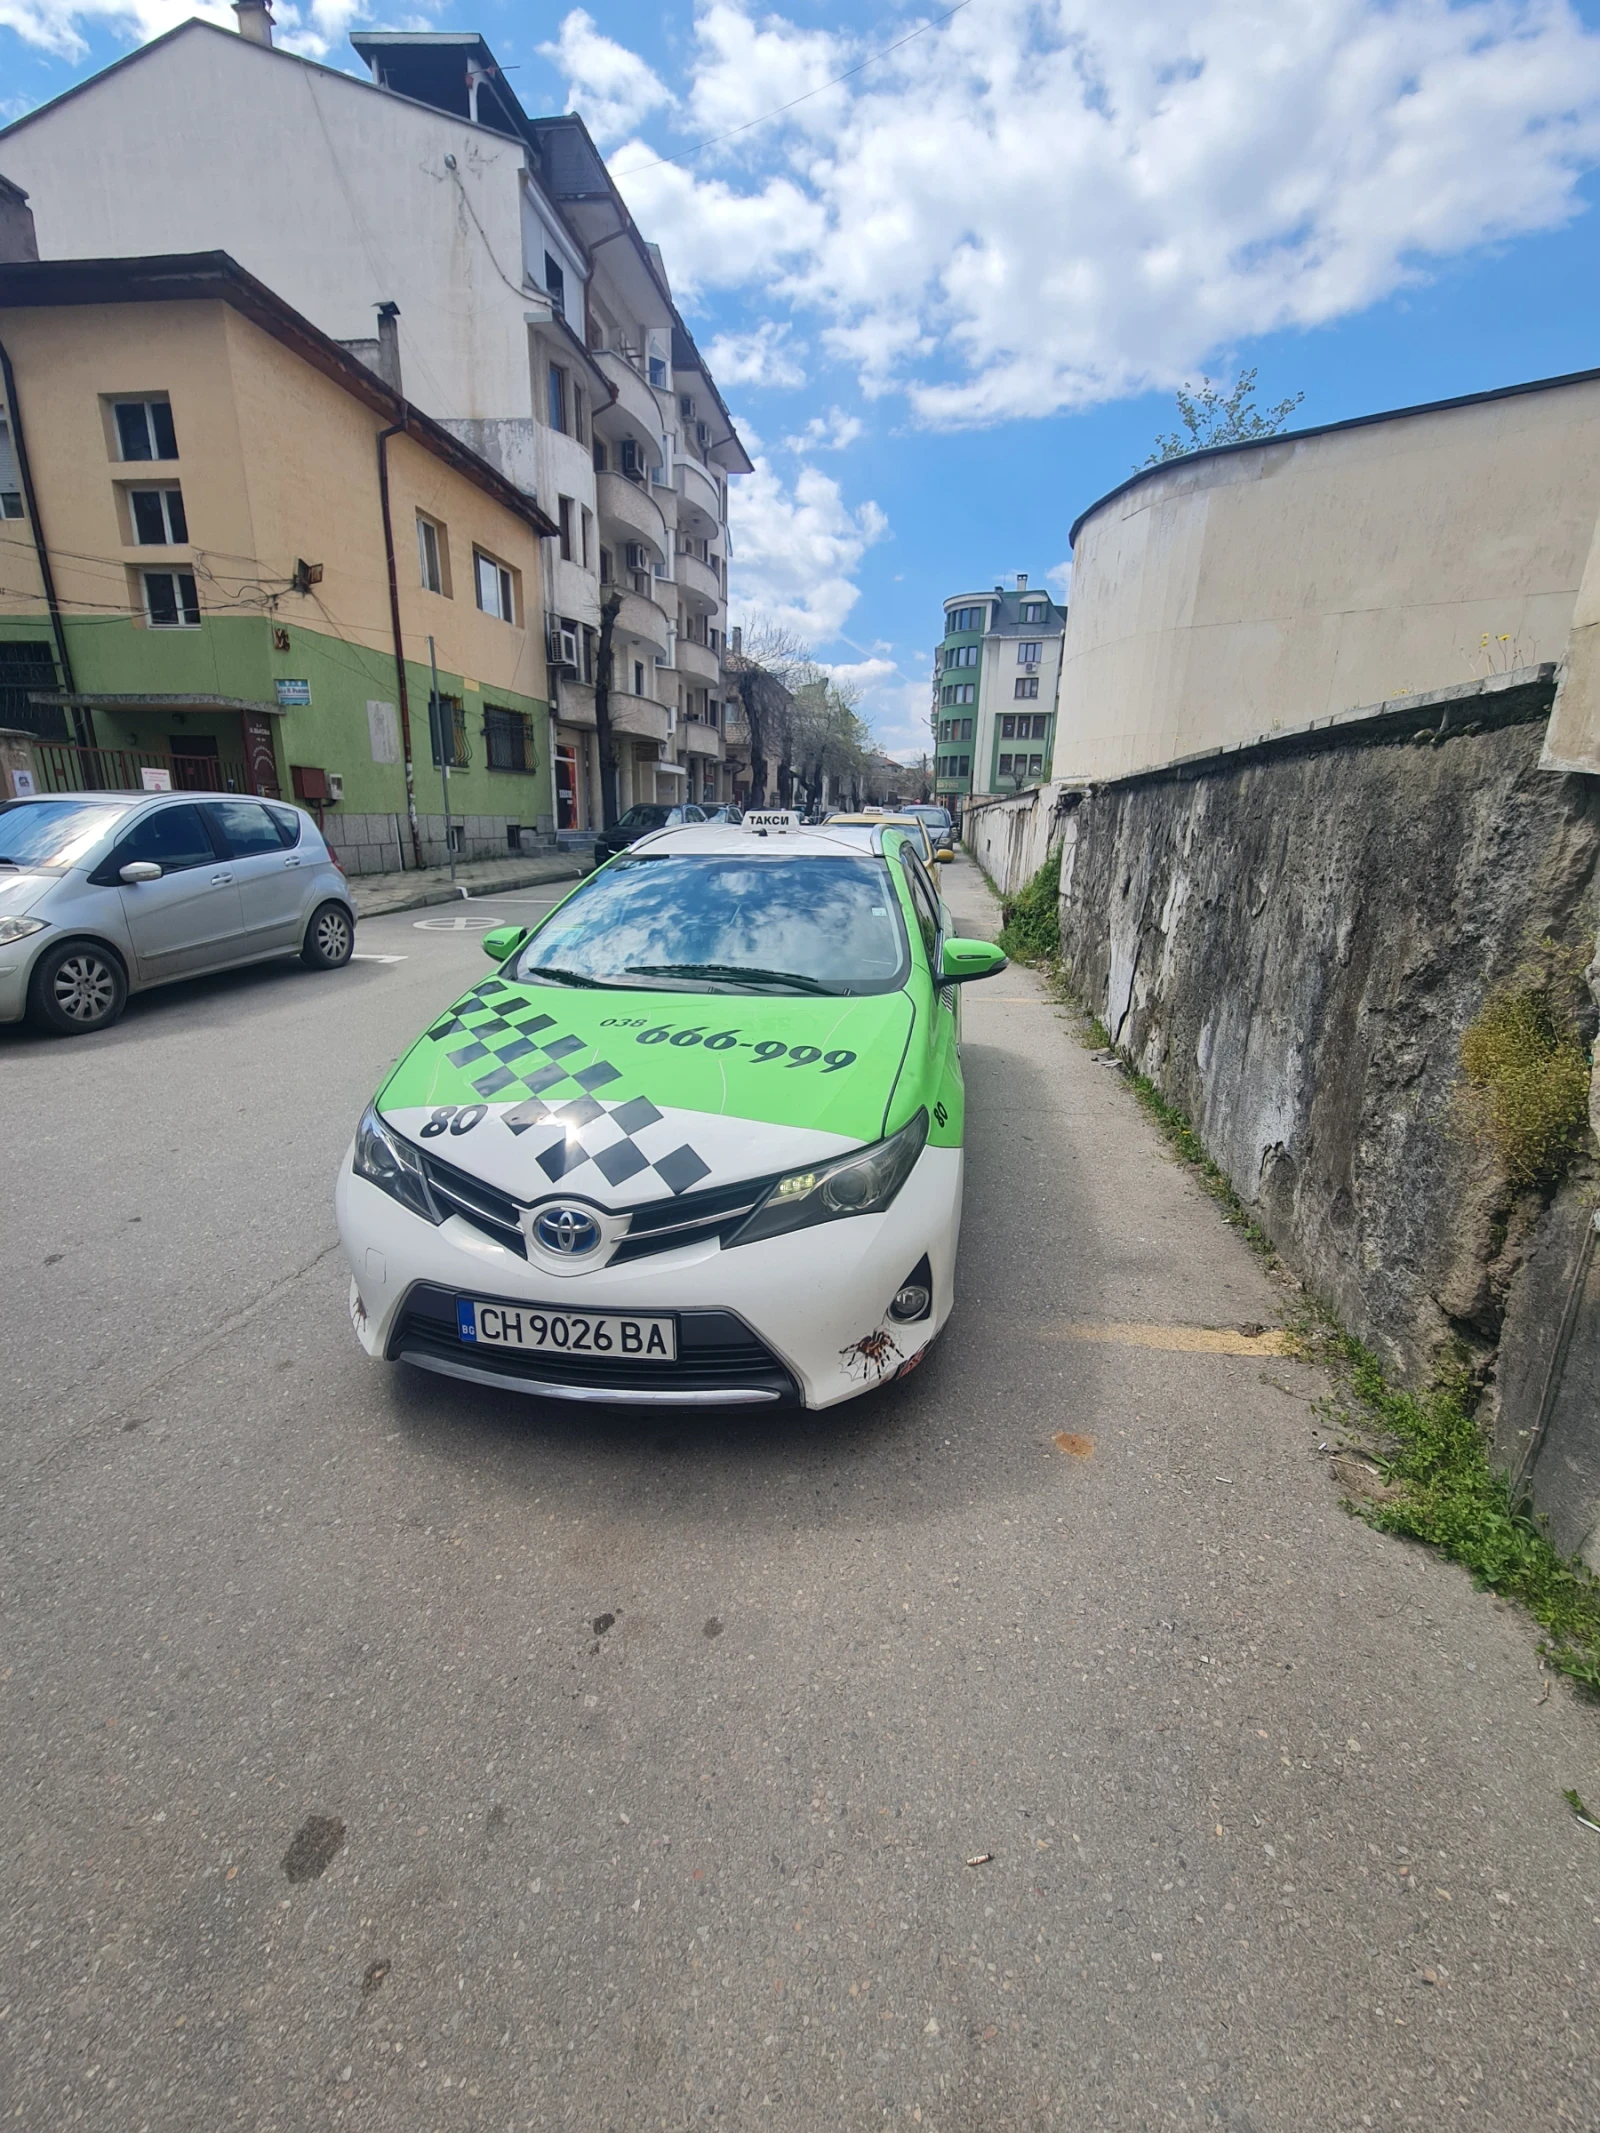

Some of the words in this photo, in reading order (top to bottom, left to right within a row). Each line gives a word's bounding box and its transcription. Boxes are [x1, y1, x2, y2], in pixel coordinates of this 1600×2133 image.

[749, 815, 789, 826] ТАКСИ
[599, 1018, 648, 1028] 038
[635, 1023, 857, 1074] 666-999
[419, 1104, 489, 1139] 80
[933, 1101, 949, 1129] 80
[461, 1324, 476, 1336] BG
[479, 1308, 524, 1344] CH
[529, 1314, 613, 1352] 9026
[620, 1321, 668, 1355] BA
